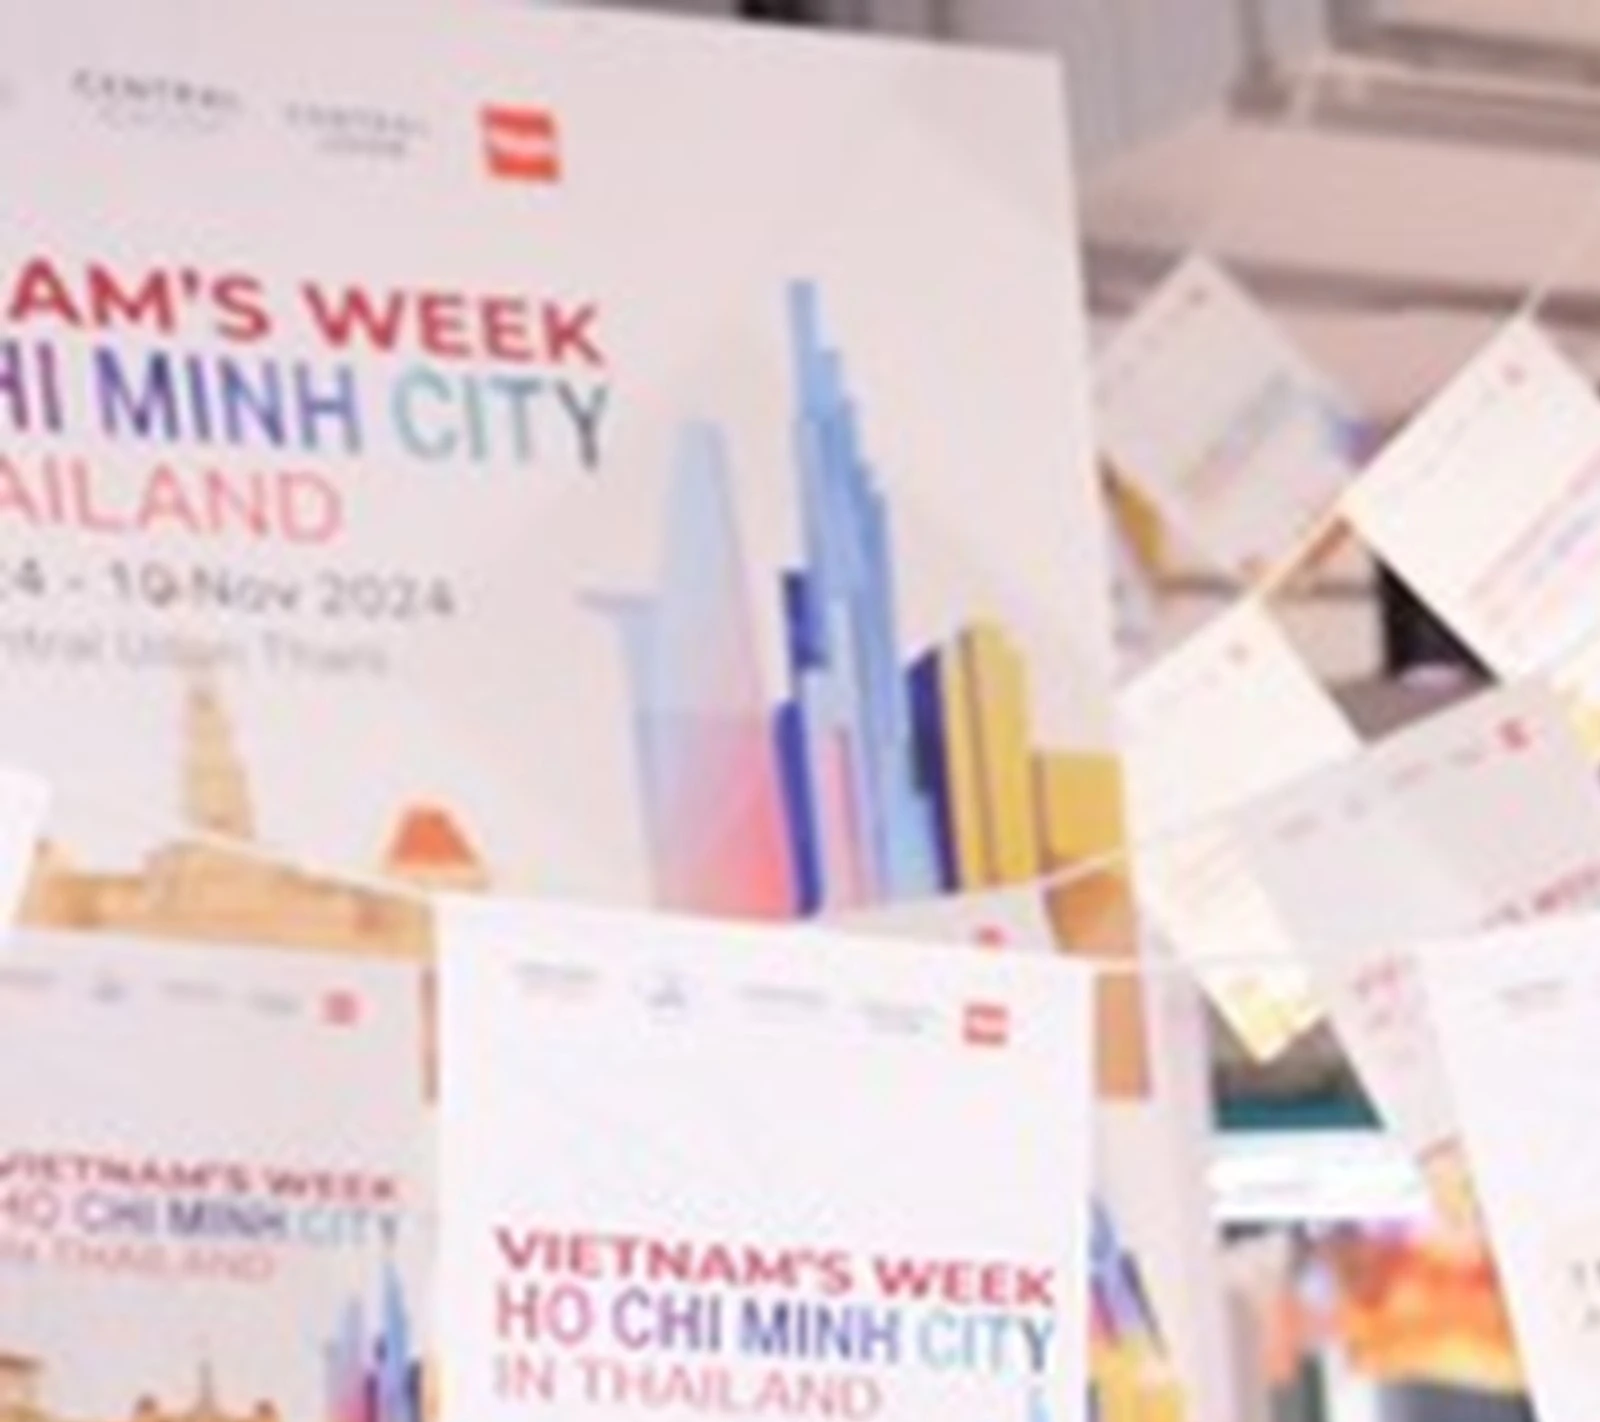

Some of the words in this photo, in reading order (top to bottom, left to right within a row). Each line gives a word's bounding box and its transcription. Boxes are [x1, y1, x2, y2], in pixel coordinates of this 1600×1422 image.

[7, 257, 272, 342] AM'S
[302, 281, 606, 367] WEEK
[94, 346, 362, 455] MINH
[391, 364, 610, 471] CITY
[316, 571, 457, 620] 2024
[494, 1224, 856, 1298] VIETNAM'S
[873, 1252, 1057, 1308] WEEK
[496, 1279, 594, 1349] HO
[611, 1285, 723, 1354] CHI
[738, 1297, 899, 1366] MINH
[918, 1307, 1057, 1375] CITY
[495, 1353, 556, 1402] IN
[576, 1356, 882, 1422] THAILAND
